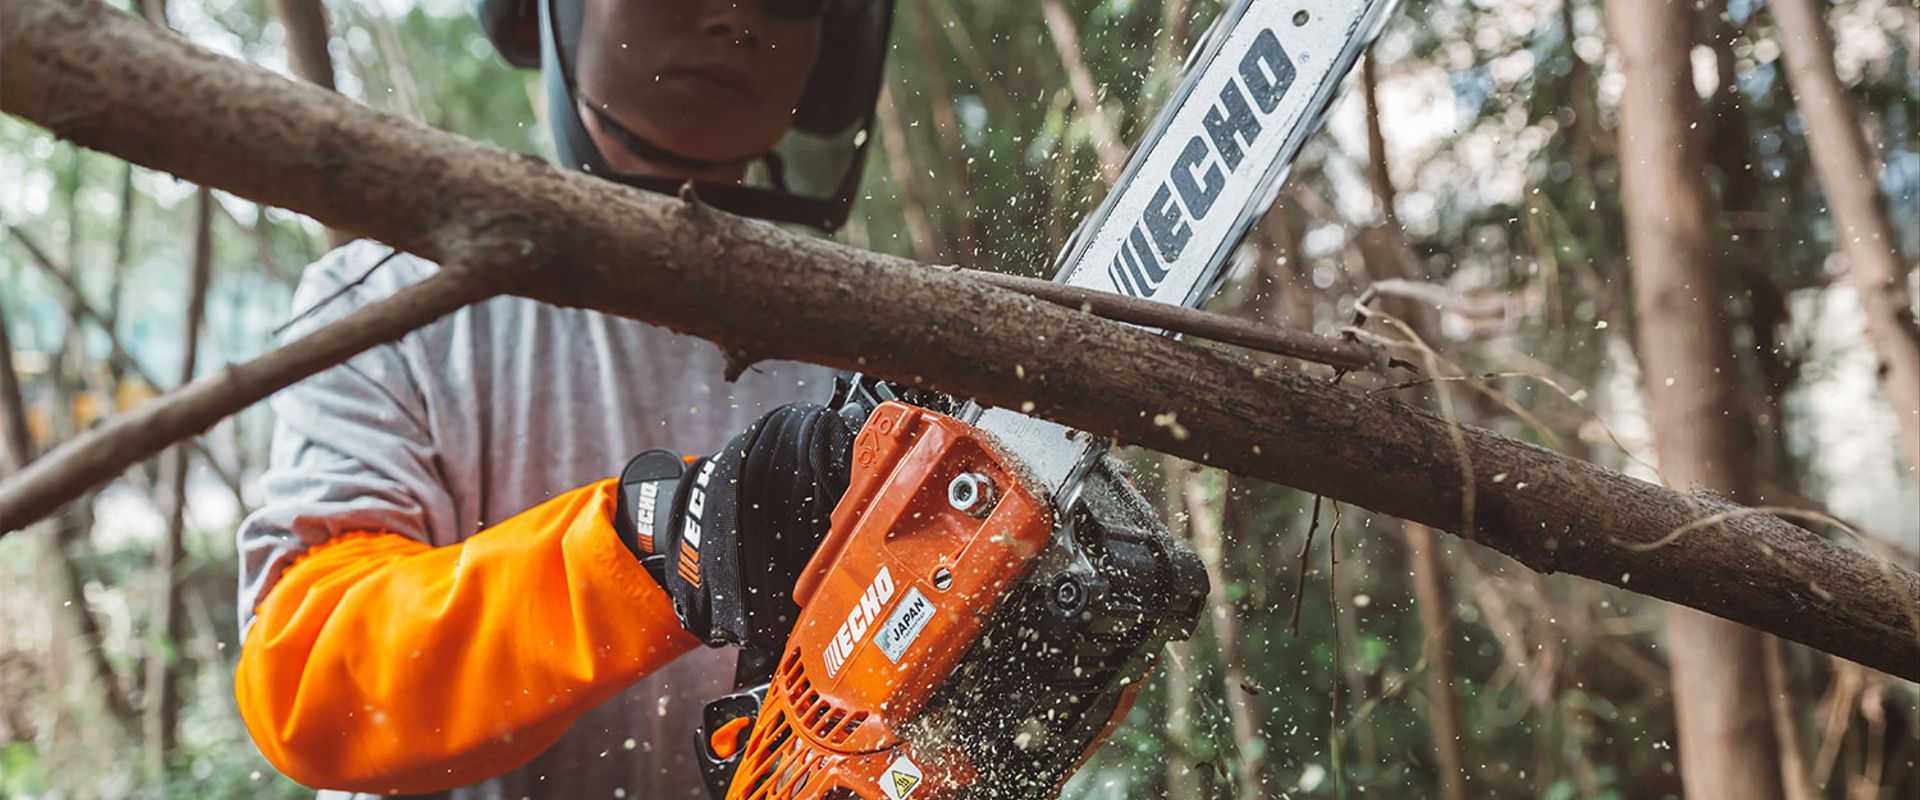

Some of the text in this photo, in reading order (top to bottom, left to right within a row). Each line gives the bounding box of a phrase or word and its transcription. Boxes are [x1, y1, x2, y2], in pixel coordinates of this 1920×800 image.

[1143, 28, 1297, 263] ECHO
[637, 481, 658, 537] ECHO
[836, 565, 895, 657] ECHO
[892, 597, 925, 642] JAPAN
